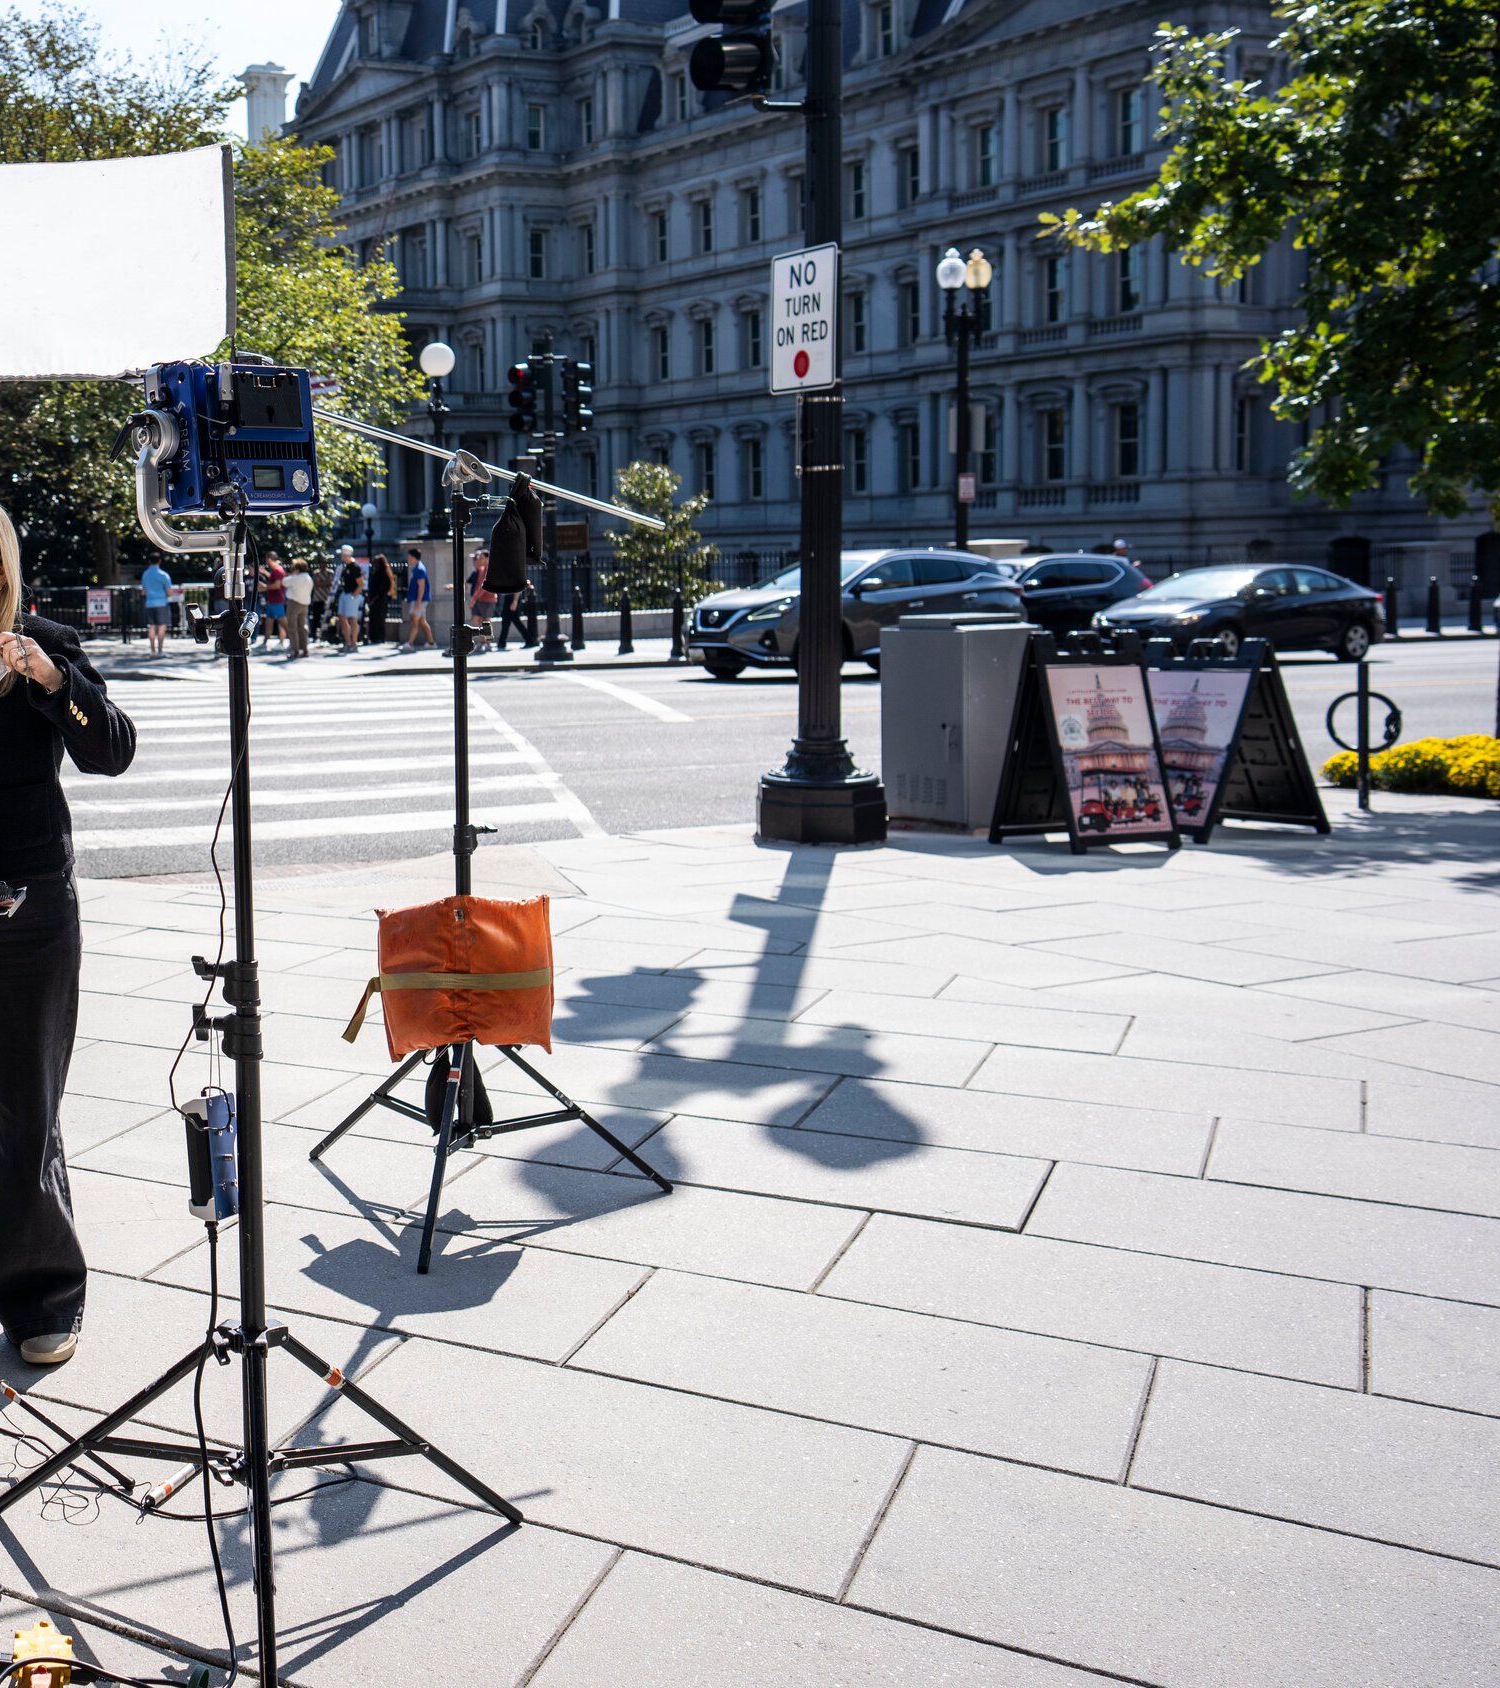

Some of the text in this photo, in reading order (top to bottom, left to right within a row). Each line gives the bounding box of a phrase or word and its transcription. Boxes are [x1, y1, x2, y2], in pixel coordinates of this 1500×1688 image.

[789, 260, 816, 289] NO
[785, 292, 821, 317] TURN
[777, 320, 828, 347] ON RED
[1066, 697, 1081, 705] THE
[1083, 697, 1101, 705] BEST
[1122, 695, 1133, 704] TO
